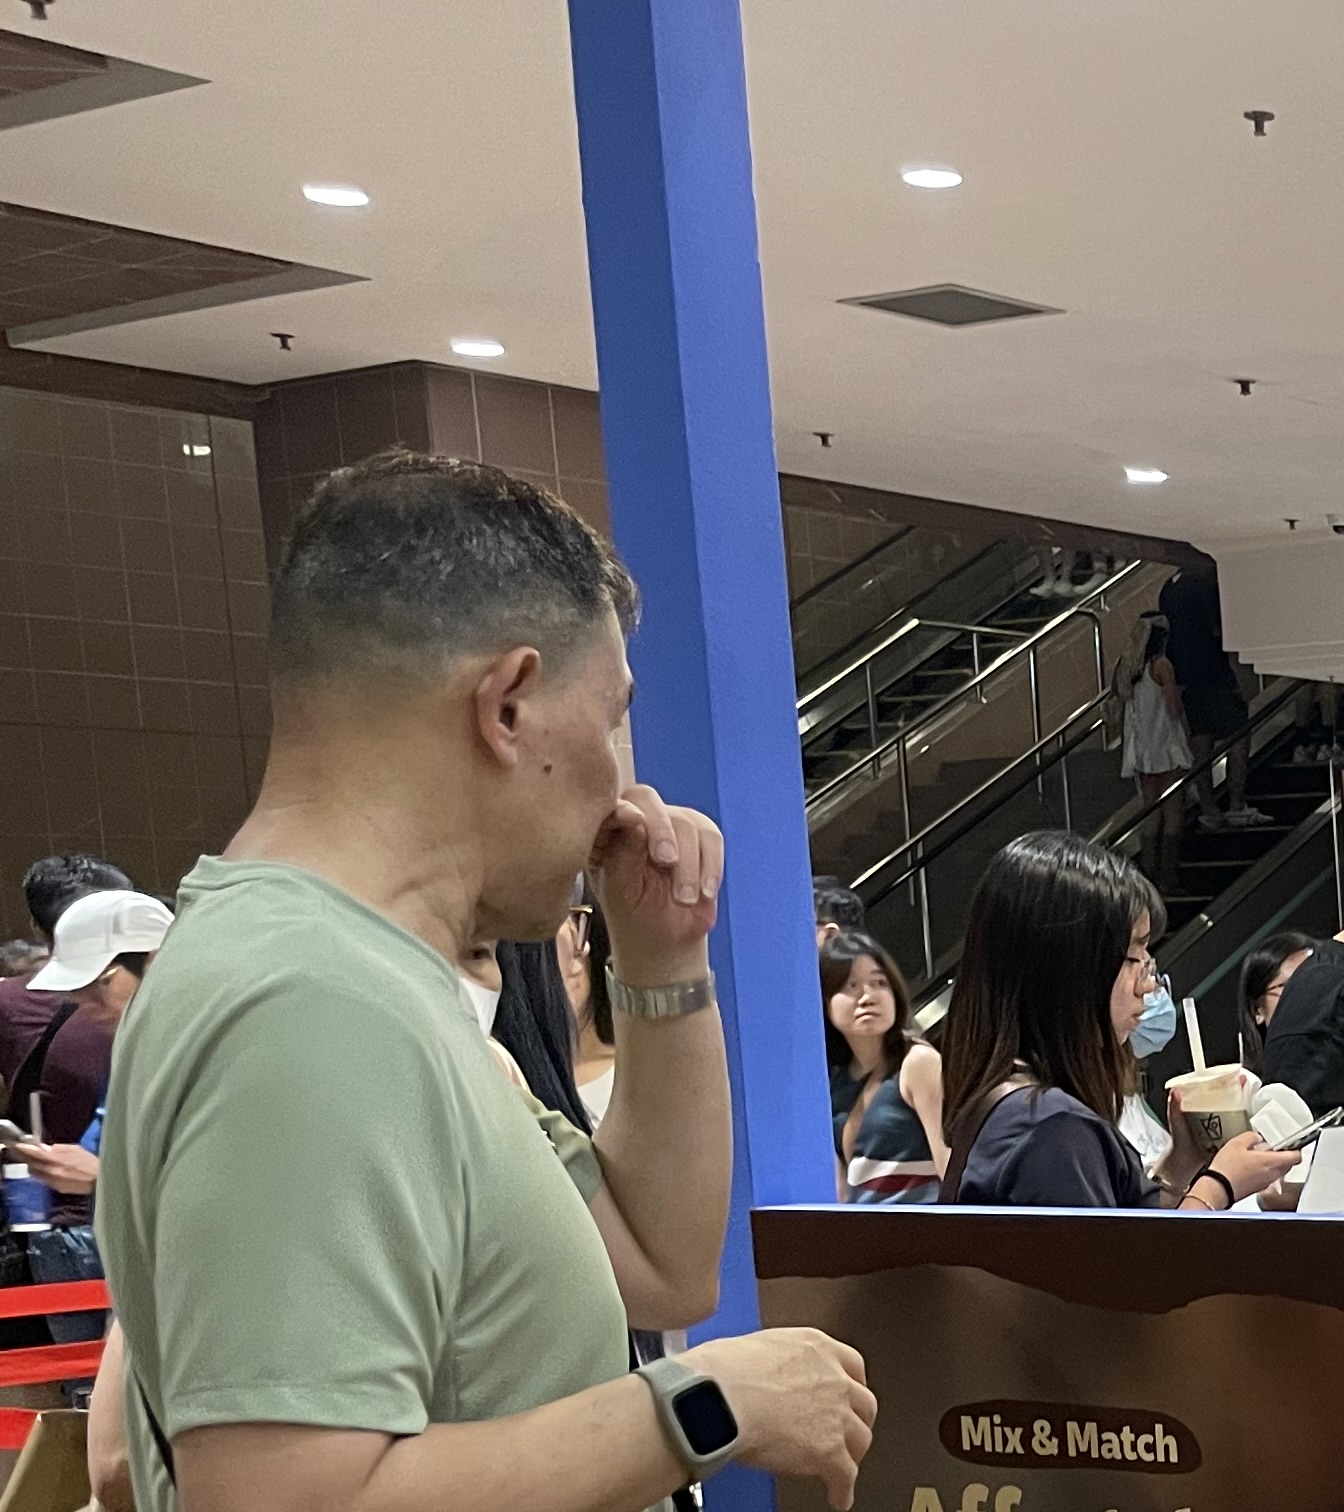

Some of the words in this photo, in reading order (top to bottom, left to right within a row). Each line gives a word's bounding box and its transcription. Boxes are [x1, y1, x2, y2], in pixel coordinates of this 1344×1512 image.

[960, 1415, 1025, 1455] Mix
[1031, 1419, 1058, 1457] &
[1067, 1421, 1179, 1464] Match
